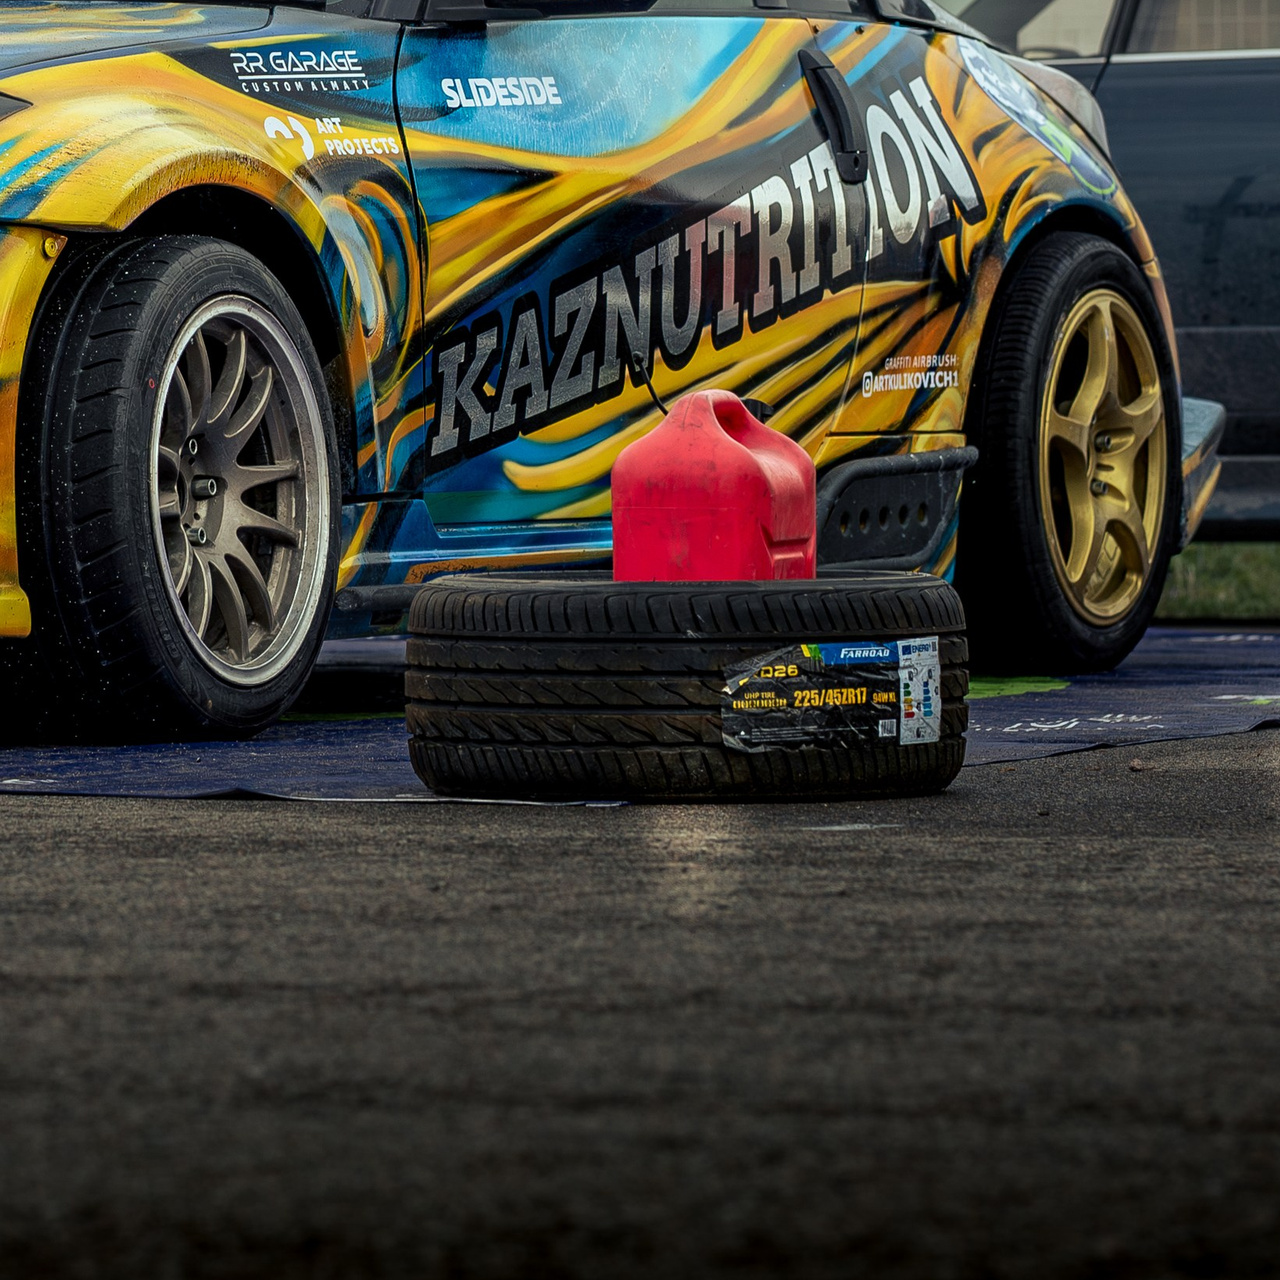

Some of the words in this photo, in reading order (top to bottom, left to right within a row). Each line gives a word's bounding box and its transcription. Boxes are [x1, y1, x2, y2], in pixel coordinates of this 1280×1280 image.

[230, 53, 267, 73] RR
[269, 50, 362, 72] GARAGE
[241, 81, 304, 92] CUSTOM
[310, 80, 370, 91] ALMATY
[441, 76, 562, 108] SLIDESIDE
[315, 117, 343, 134] ART
[324, 137, 399, 156] PROJECTS
[431, 76, 979, 457] KAZNUTRITION
[885, 356, 912, 370] GRAFFITI
[840, 647, 890, 658] FARROAD
[794, 688, 867, 707] 225/45ZR17
